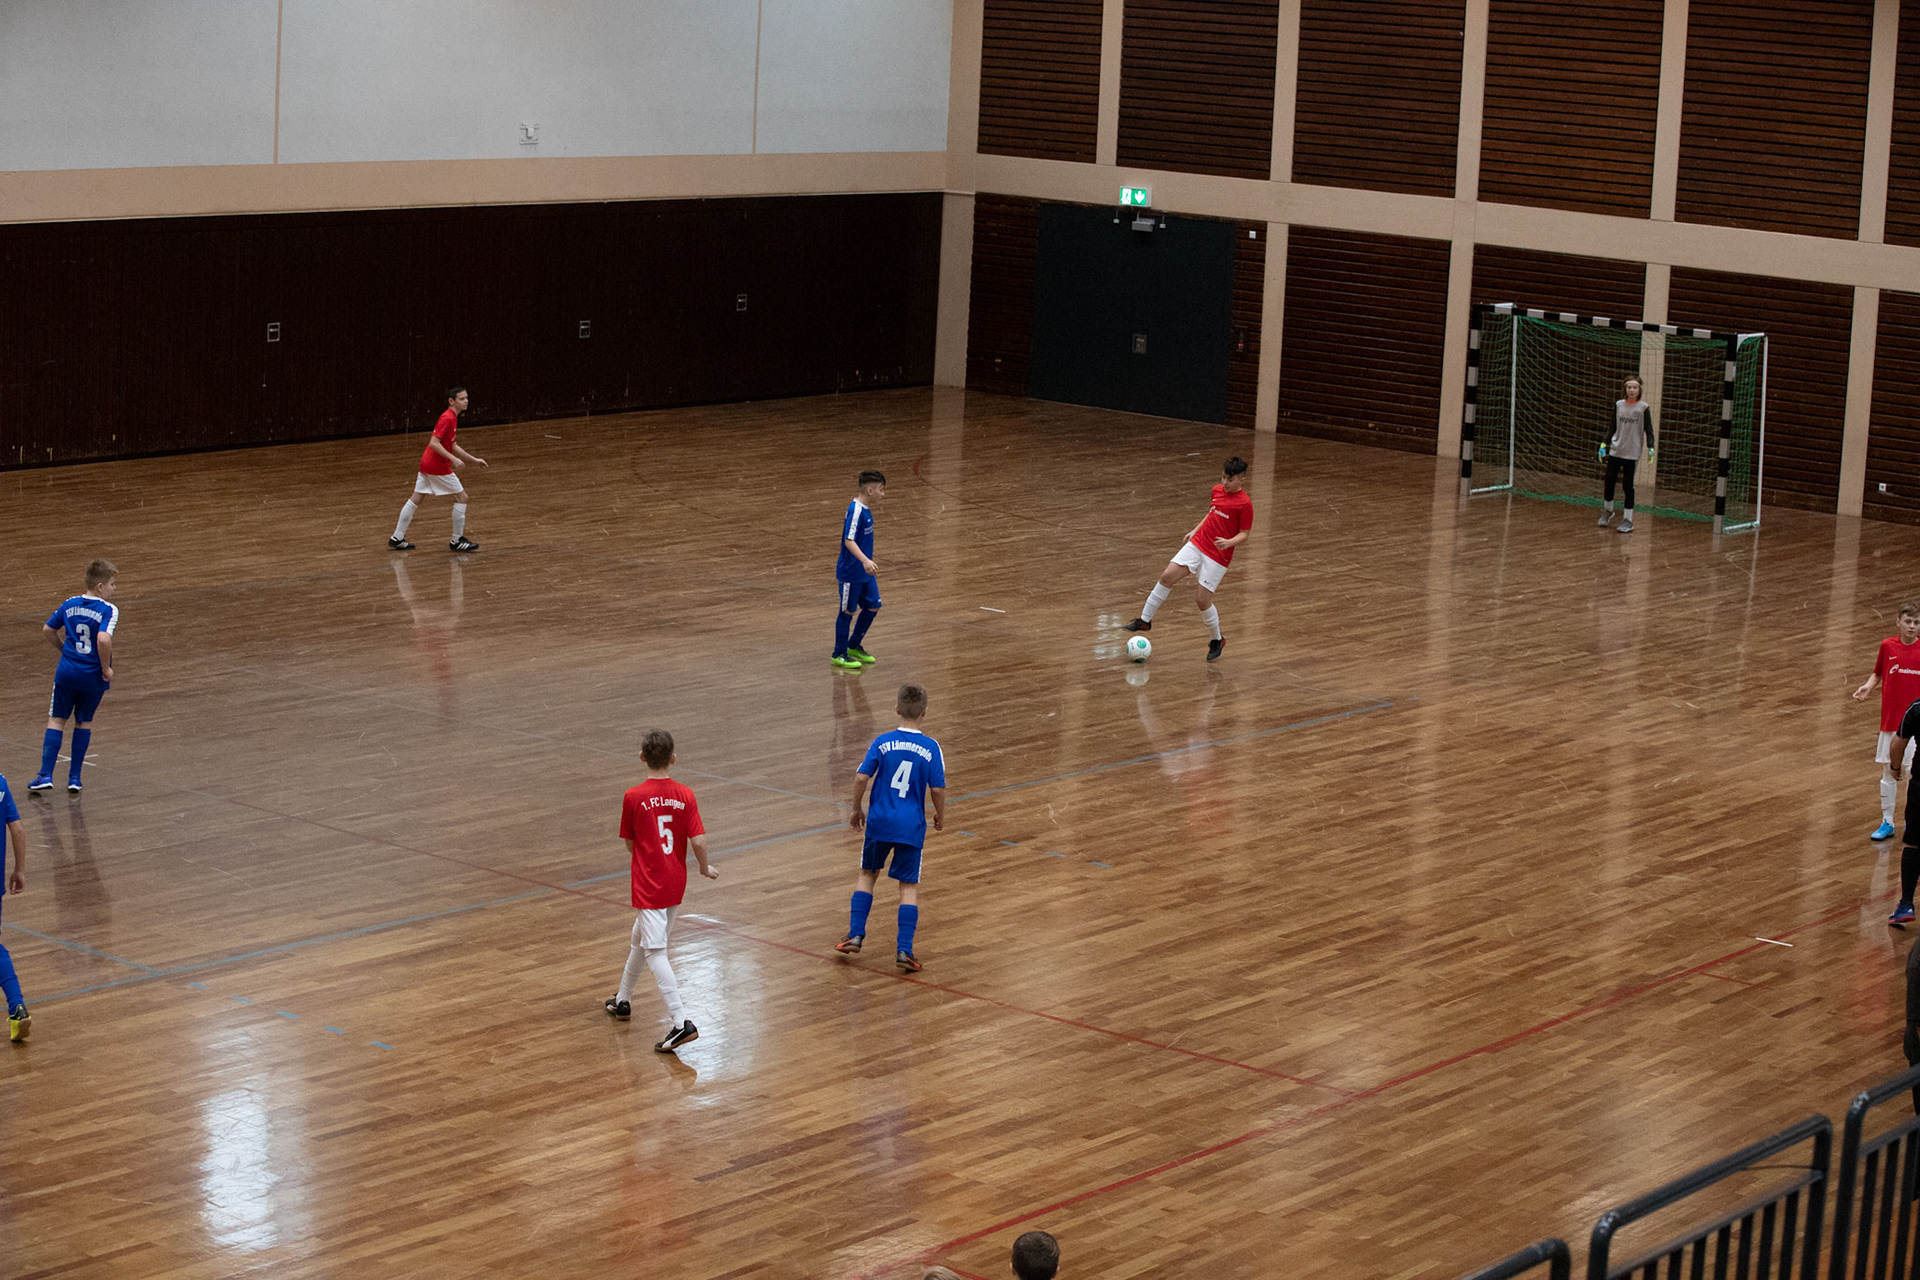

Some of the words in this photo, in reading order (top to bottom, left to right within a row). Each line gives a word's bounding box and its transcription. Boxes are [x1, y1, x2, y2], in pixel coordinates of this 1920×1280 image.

[75, 623, 92, 655] 3
[878, 740, 891, 756] TSV
[890, 760, 913, 799] 4
[641, 801, 651, 811] 1.
[649, 796, 660, 808] FC
[657, 814, 674, 855] 5
